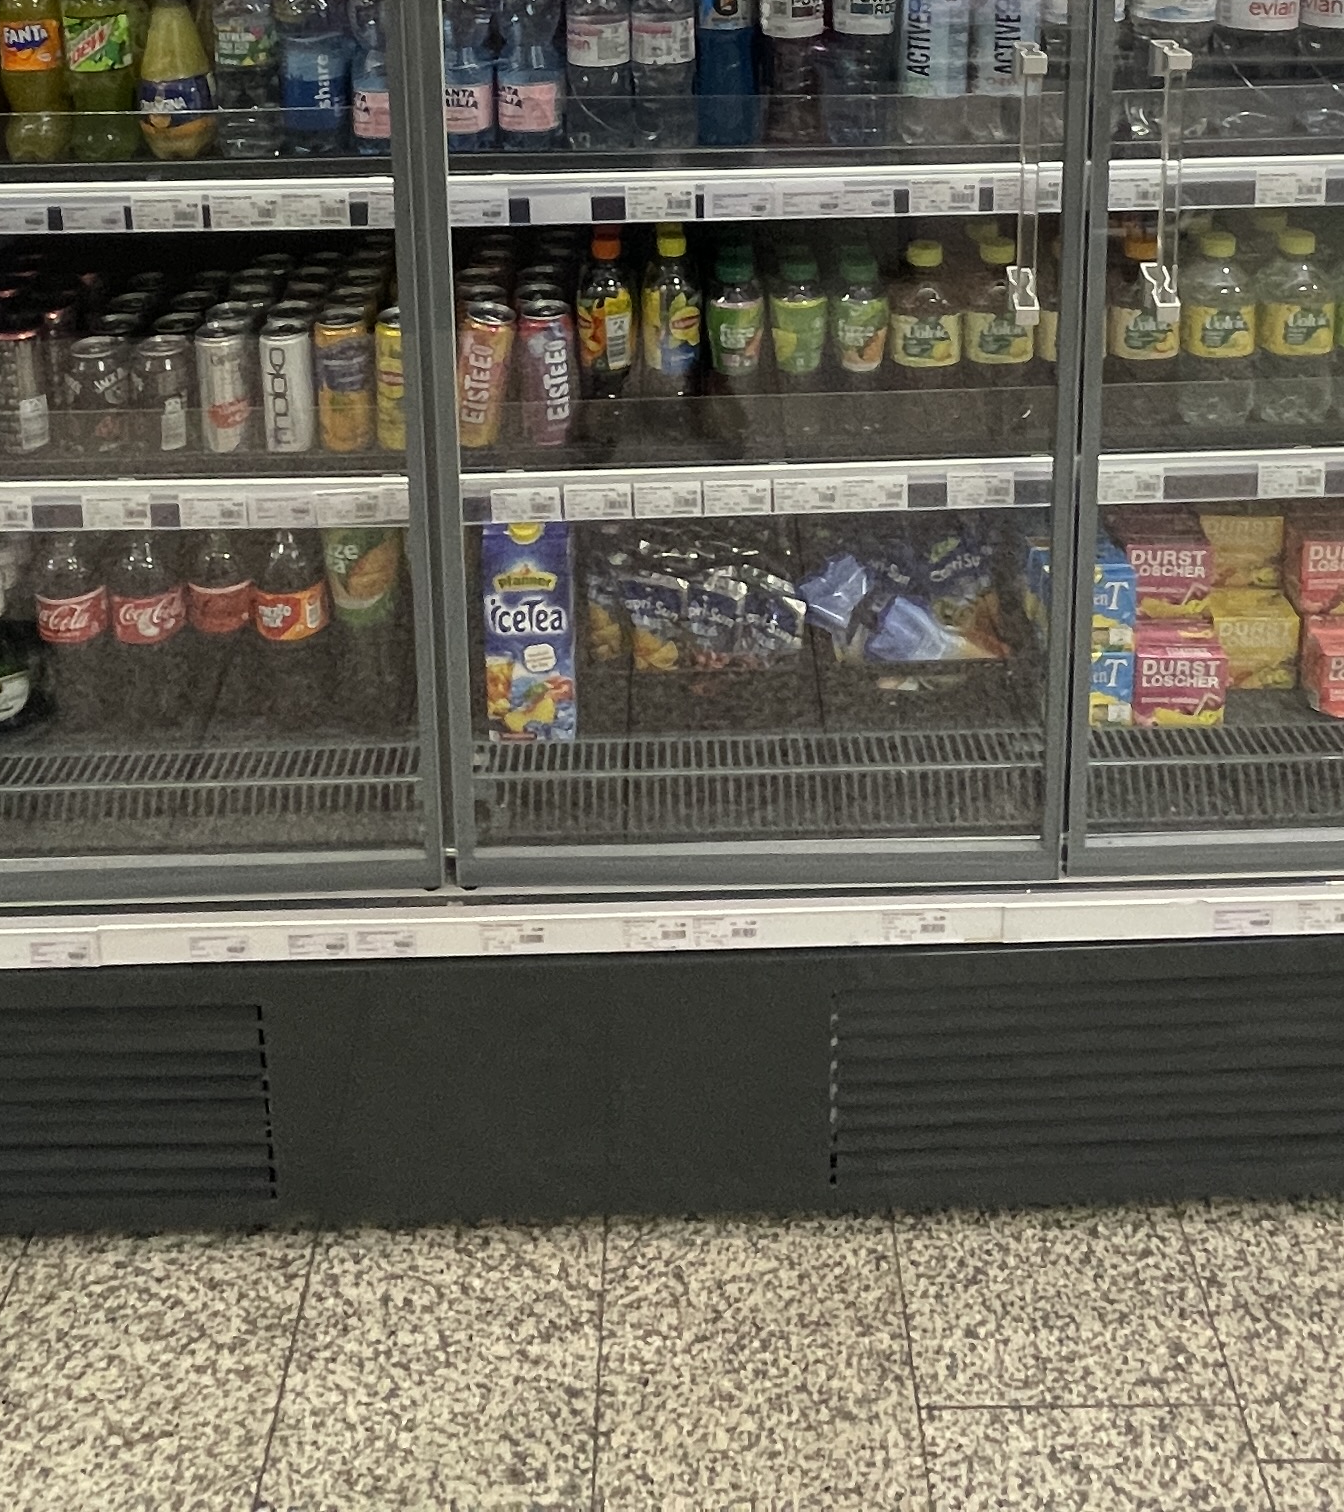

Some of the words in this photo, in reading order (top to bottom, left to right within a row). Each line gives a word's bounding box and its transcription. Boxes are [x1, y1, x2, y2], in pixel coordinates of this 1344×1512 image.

[1249, 0, 1297, 16] evian
[314, 54, 331, 109] share
[1131, 549, 1207, 566] DURST
[1142, 659, 1221, 676] DURST
